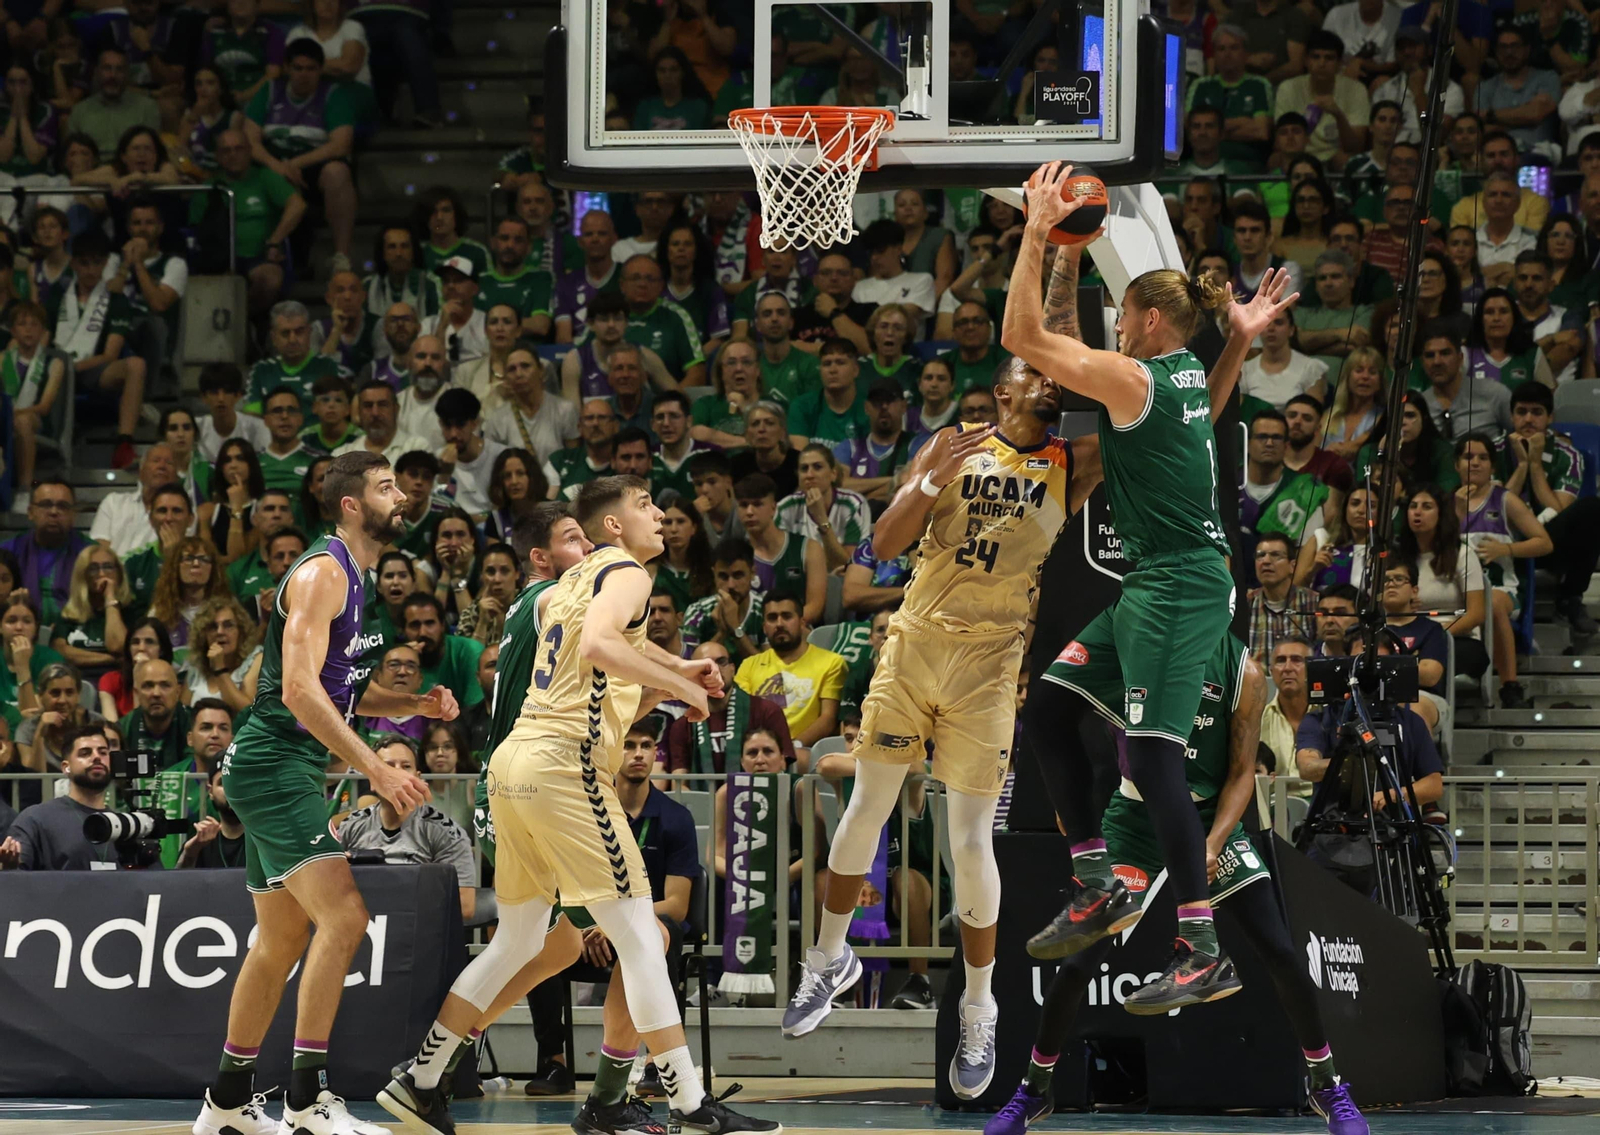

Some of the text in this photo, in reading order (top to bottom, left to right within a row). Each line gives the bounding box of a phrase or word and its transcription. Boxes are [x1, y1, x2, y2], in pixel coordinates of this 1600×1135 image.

[1043, 92, 1086, 101] PLAYOFF
[961, 474, 1047, 509] UCAM
[967, 501, 1025, 520] MURCIA
[955, 537, 1000, 574] 24
[534, 623, 564, 690] 3
[731, 775, 770, 915] ICAJA
[1543, 856, 1551, 865] 3
[1501, 918, 1510, 928] 2
[1320, 936, 1365, 964] Fundación
[1326, 965, 1360, 1000] Unicaja
